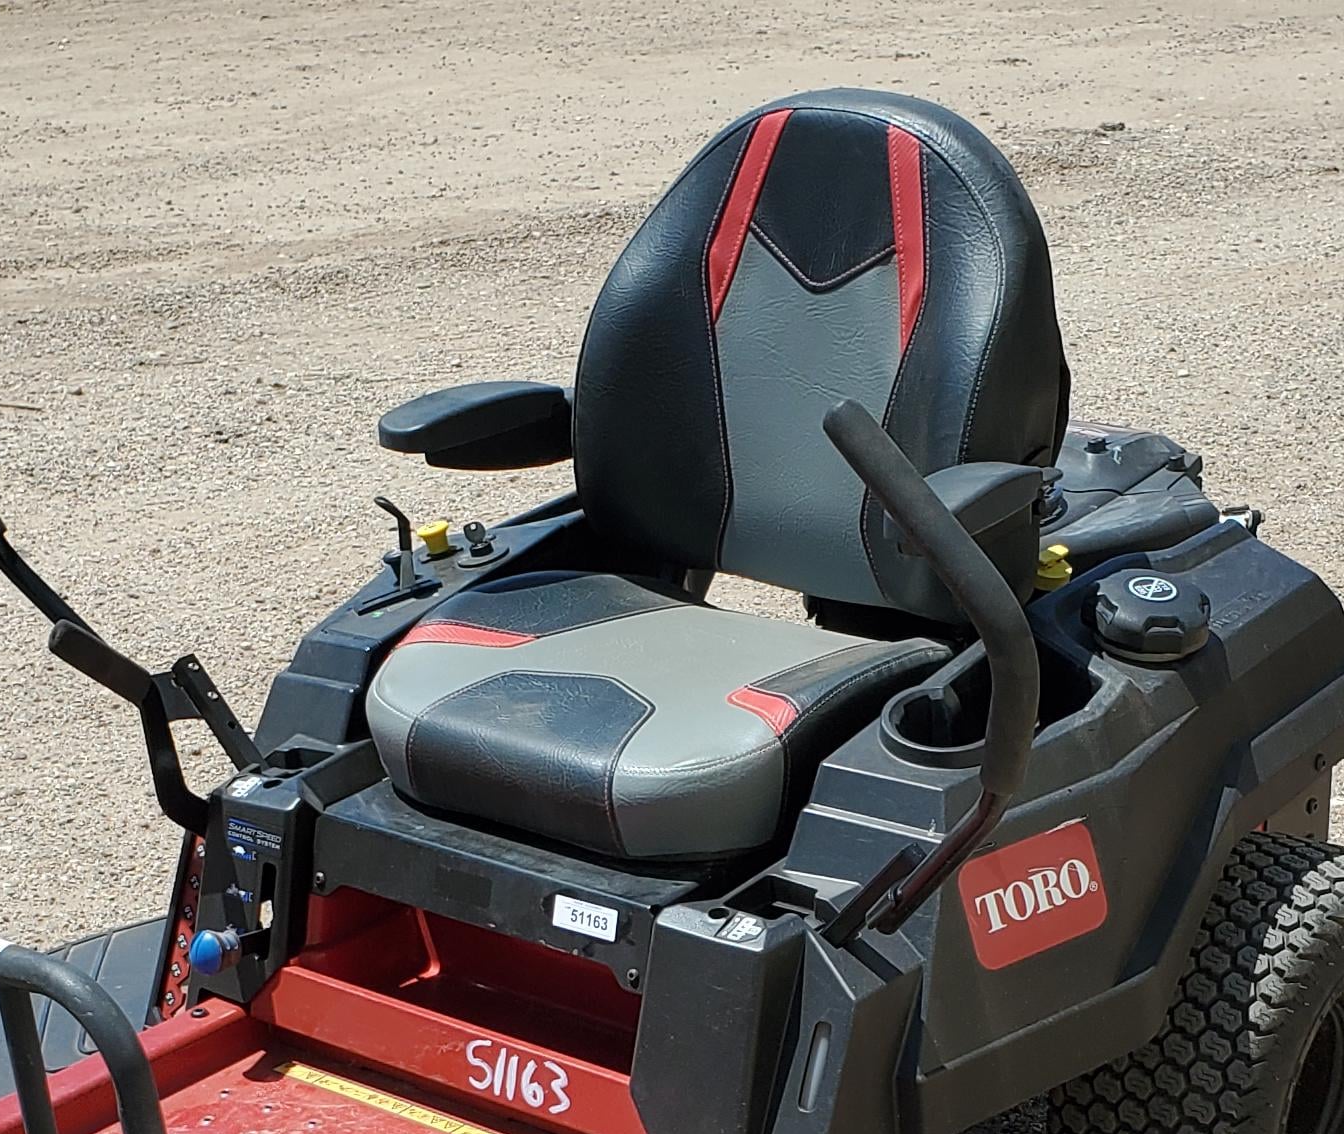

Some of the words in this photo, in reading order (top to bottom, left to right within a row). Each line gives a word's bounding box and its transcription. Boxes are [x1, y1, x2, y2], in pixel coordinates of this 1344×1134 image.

[227, 830, 254, 842] CONTROL
[256, 838, 281, 850] SYSTEM
[570, 909, 608, 931] 51163
[975, 859, 1090, 933] TORO
[466, 1039, 571, 1114] 51163
